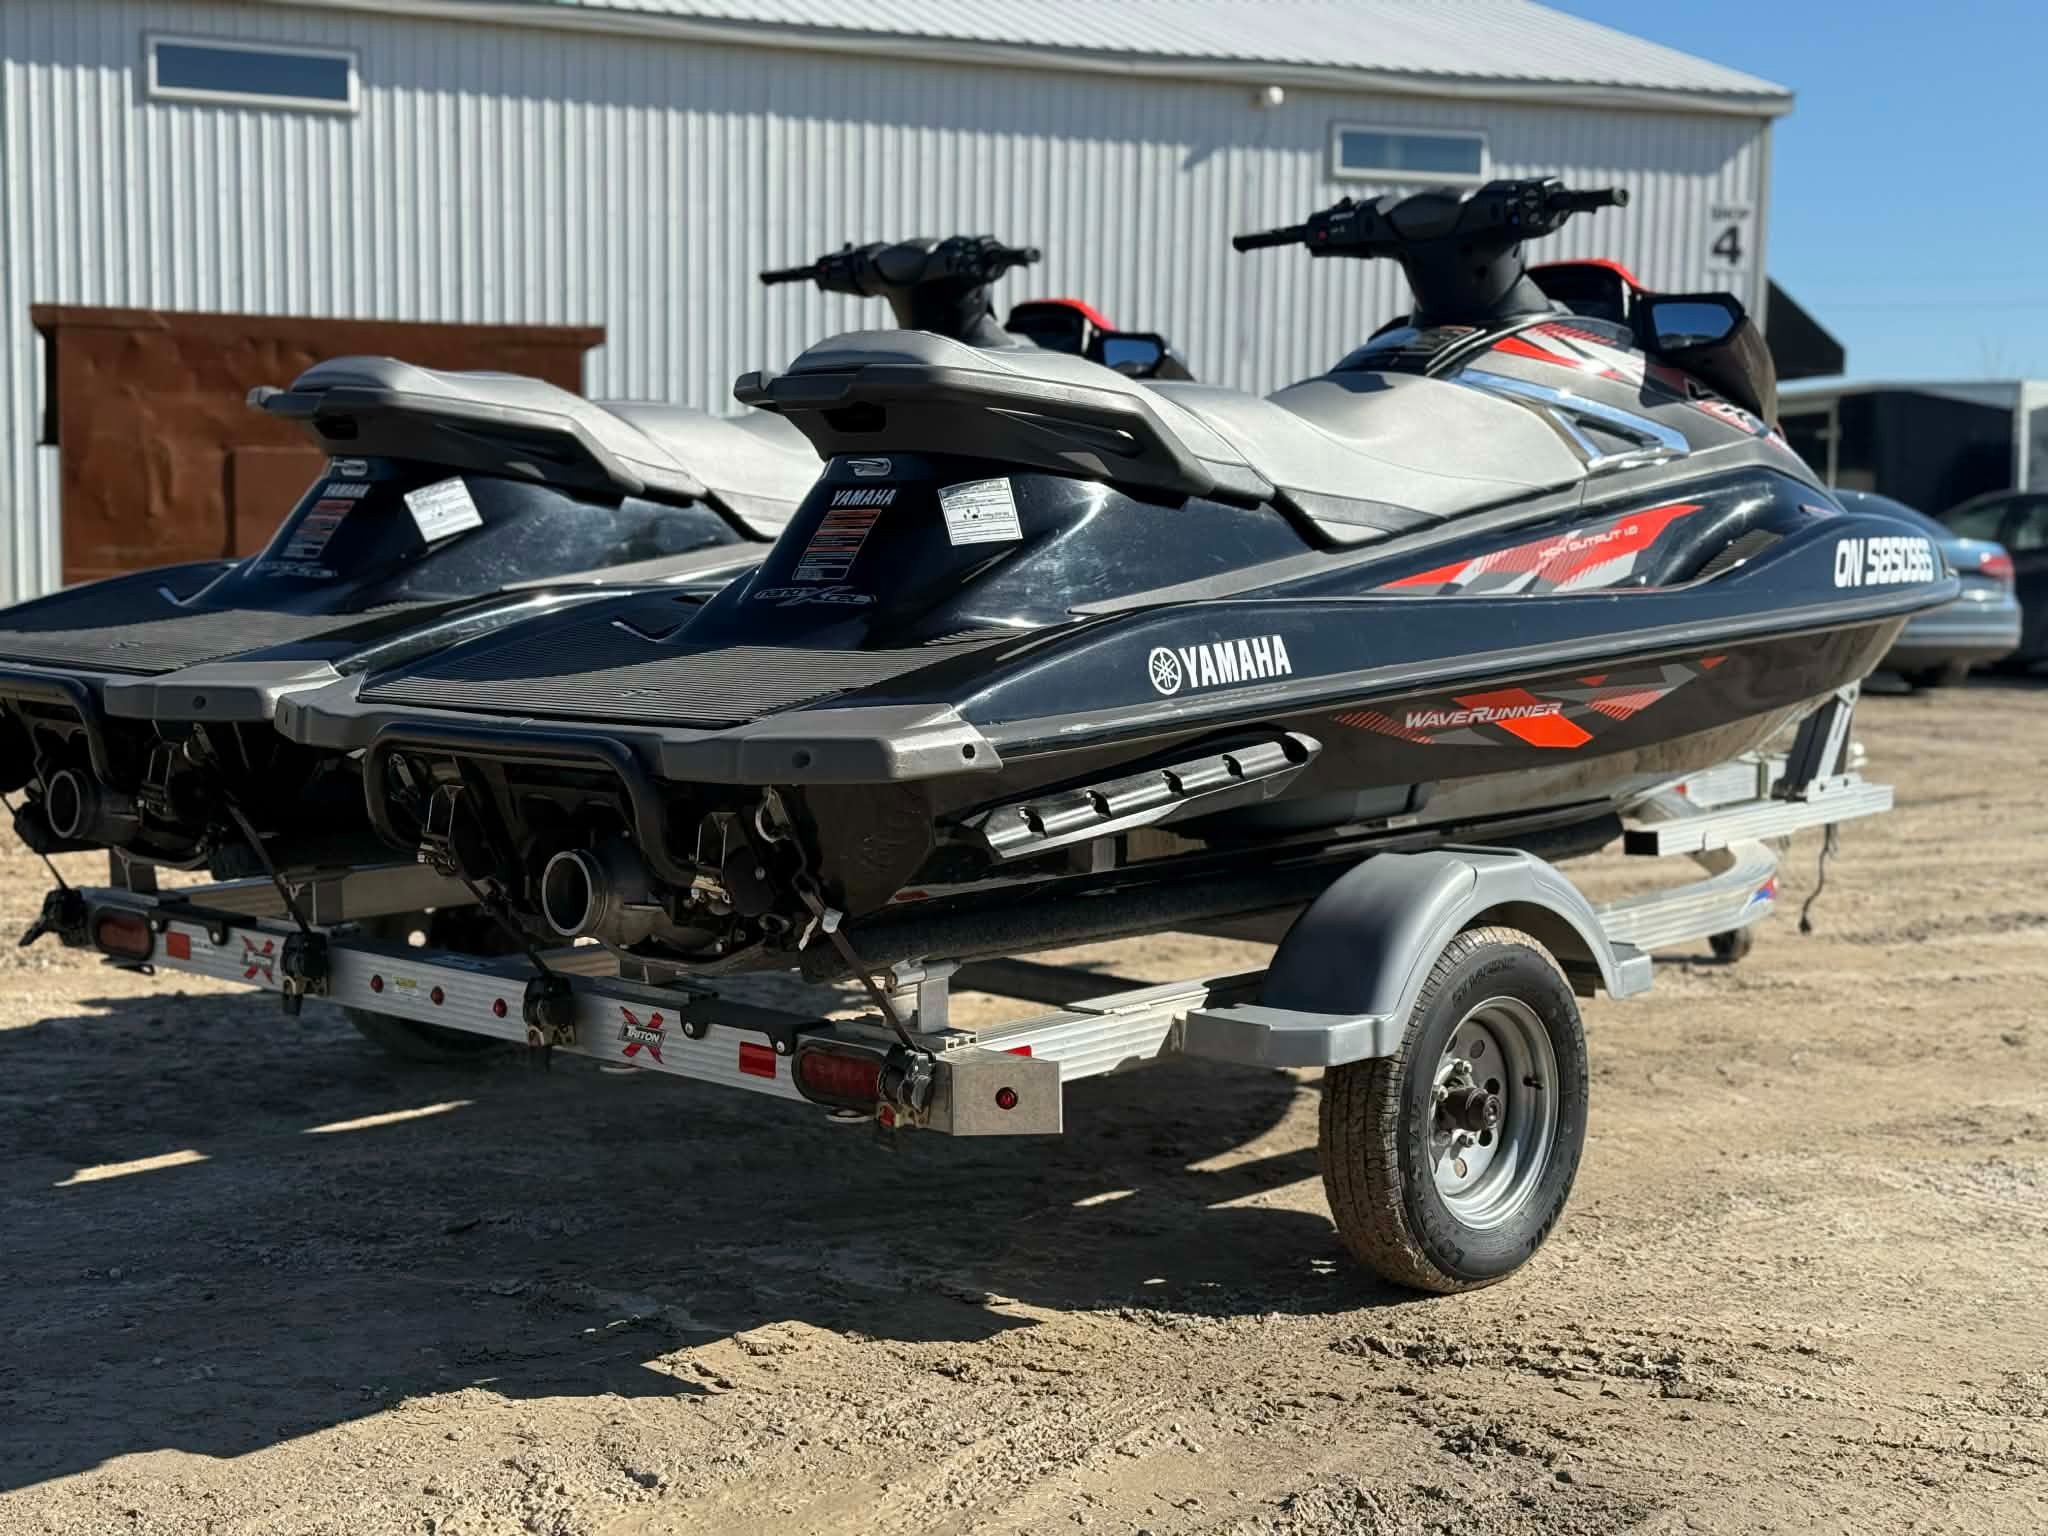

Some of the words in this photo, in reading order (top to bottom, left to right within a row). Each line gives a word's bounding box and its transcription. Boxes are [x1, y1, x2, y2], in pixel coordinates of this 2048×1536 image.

[1711, 225, 1741, 265] 4
[831, 489, 896, 506] YAMAHA
[1835, 538, 1864, 588] ON
[1178, 634, 1292, 688] YAMAHA
[627, 1025, 660, 1042] TRITON
